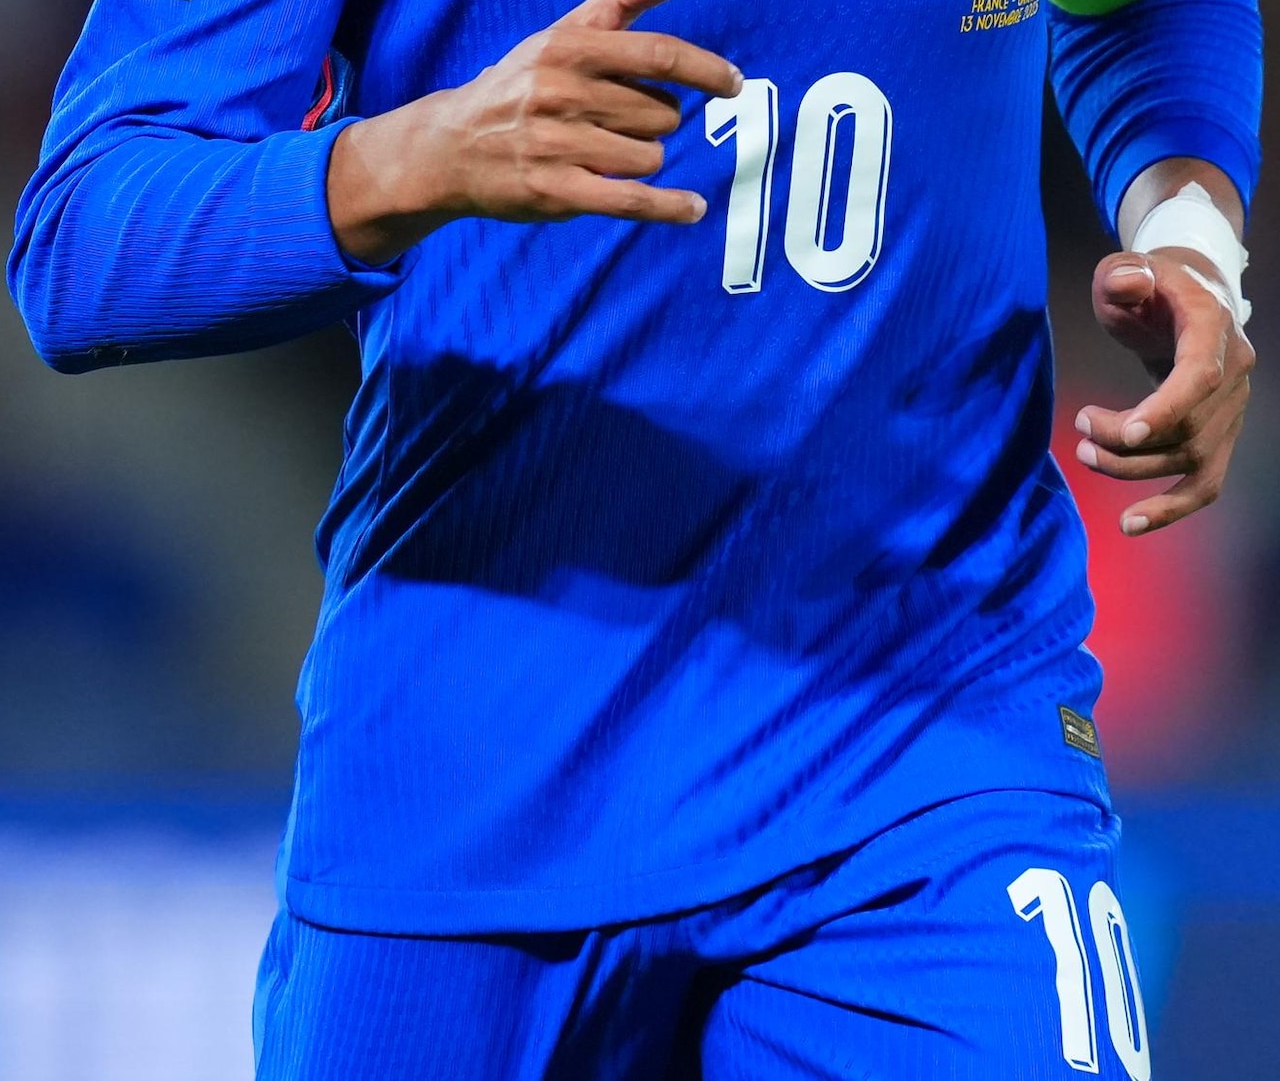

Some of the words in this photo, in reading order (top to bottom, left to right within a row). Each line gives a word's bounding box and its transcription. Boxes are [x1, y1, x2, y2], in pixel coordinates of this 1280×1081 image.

[960, 15, 974, 33] 13
[705, 71, 893, 294] 10
[1006, 867, 1152, 1081] 10
